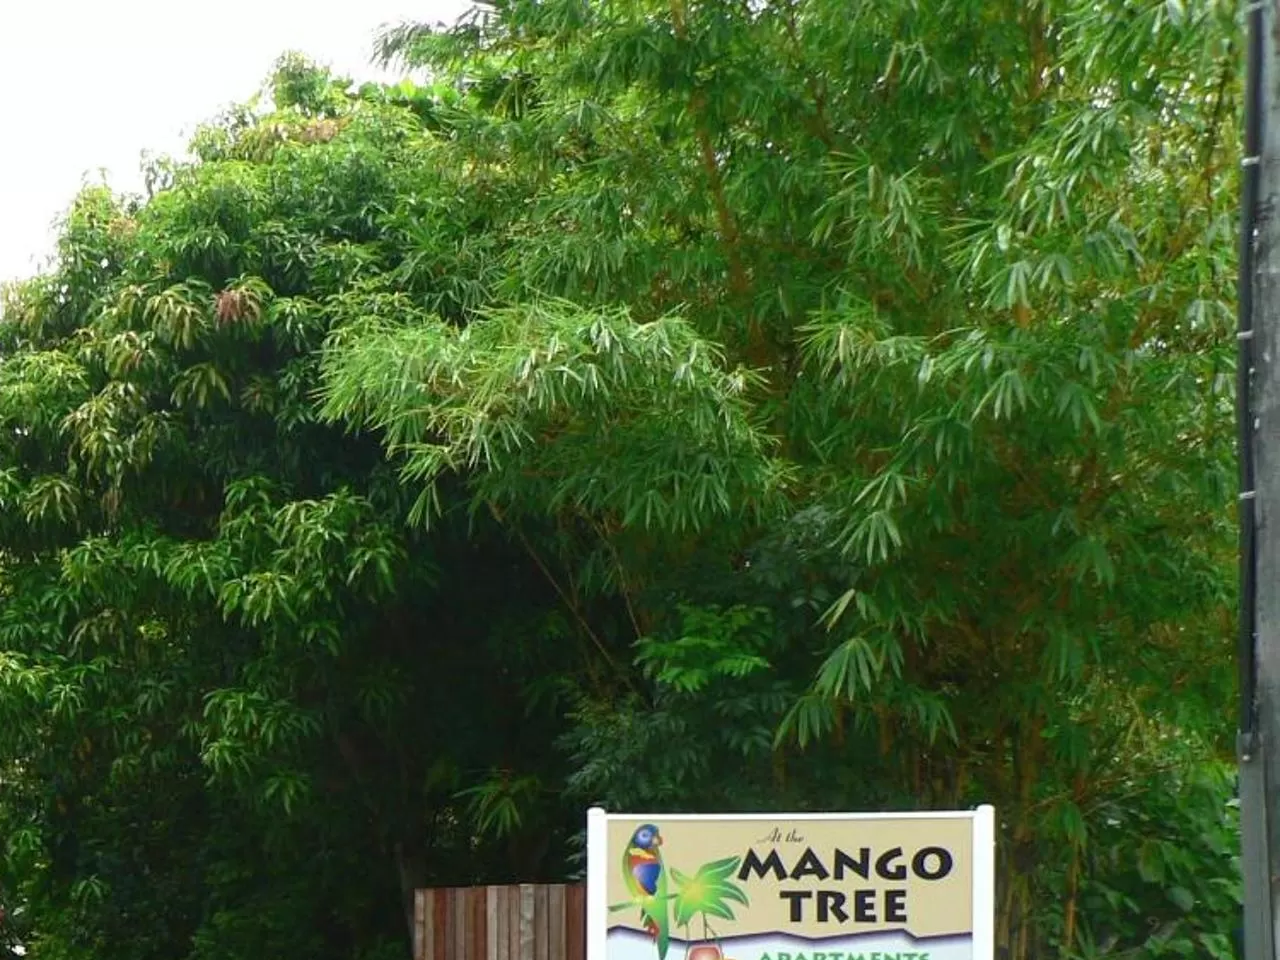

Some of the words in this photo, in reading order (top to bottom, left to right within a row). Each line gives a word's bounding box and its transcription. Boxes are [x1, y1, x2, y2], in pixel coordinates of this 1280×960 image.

[785, 830, 805, 843] the
[737, 846, 954, 881] MANGO
[779, 889, 908, 923] TREE
